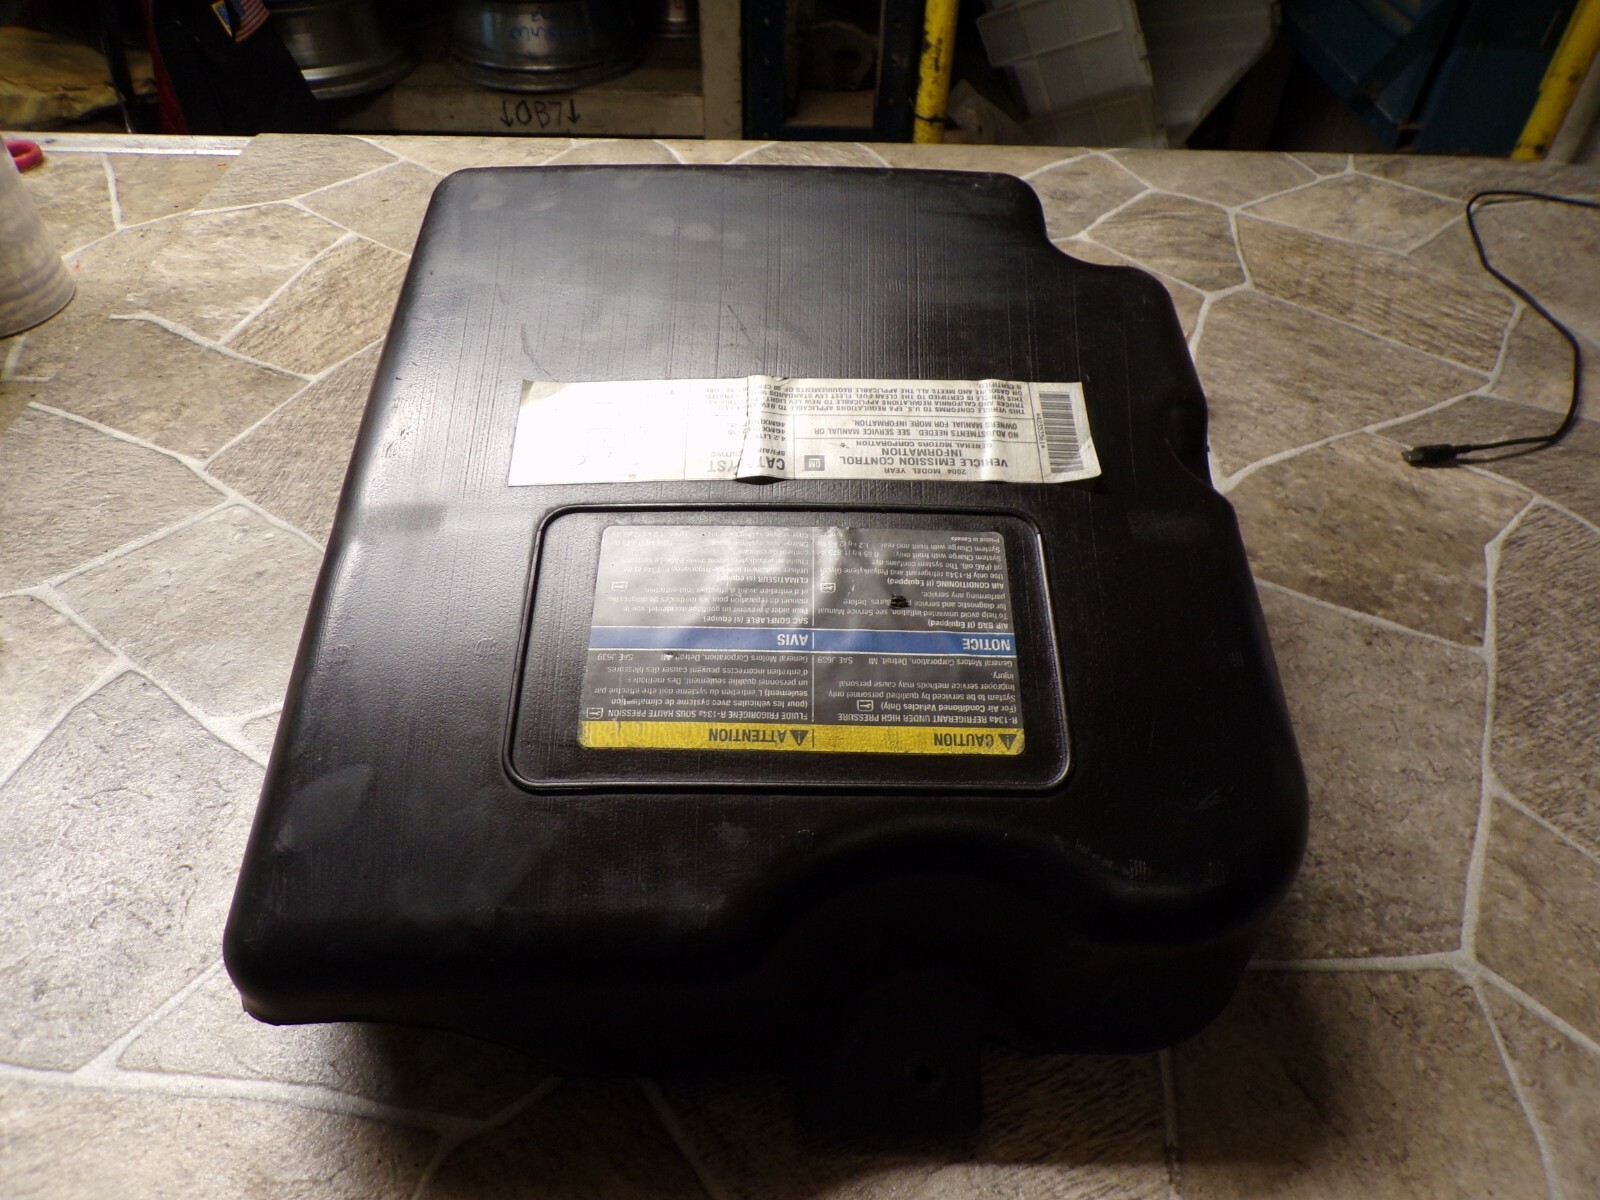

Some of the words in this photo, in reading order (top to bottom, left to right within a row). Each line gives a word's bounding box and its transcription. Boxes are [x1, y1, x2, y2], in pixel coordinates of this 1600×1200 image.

[881, 448, 962, 457] INFORMATION
[839, 456, 894, 465] CONTROL
[899, 457, 955, 466] EMISSION
[960, 458, 1008, 467] VEHICLE
[948, 544, 973, 552] Charge
[948, 552, 973, 561] Charge
[975, 562, 992, 570] (PAG
[844, 567, 888, 575] Polyalkylene
[887, 577, 924, 587] Equipped)
[936, 580, 989, 588] CONDITIONING
[966, 591, 1005, 600] performing
[958, 601, 995, 609] diagnostic
[846, 608, 874, 616] Service
[983, 611, 997, 619] help
[746, 616, 790, 624] GONFLABLE
[928, 619, 965, 628] Equipped)
[777, 633, 809, 646] AVIS
[961, 638, 1011, 652] NOTICE
[839, 656, 853, 664] SAE
[957, 659, 983, 667] Motors
[984, 660, 1012, 668] General
[690, 666, 720, 674] peuvent
[722, 667, 765, 675] incorrectes
[990, 672, 1014, 680] injury.
[898, 680, 914, 688] may
[916, 682, 949, 690] methods
[981, 682, 1015, 691] Improper
[765, 689, 808, 697] seulement)
[826, 690, 845, 698] only.
[846, 691, 884, 699] personnel
[886, 692, 919, 700] qualified
[922, 692, 930, 700] by
[932, 693, 964, 701] serviced
[987, 694, 1015, 702] System
[787, 700, 808, 708] (pour
[881, 702, 901, 710] Only)
[939, 704, 985, 712] Conditioned
[608, 709, 647, 717] PRESSION
[781, 712, 808, 720] FLUIDE
[837, 713, 879, 721] PRESSURE
[933, 715, 986, 723] REFRIGERANT
[989, 716, 1017, 724] R-134a
[709, 729, 787, 742] ATTENTION
[934, 733, 994, 746] CAUTION
